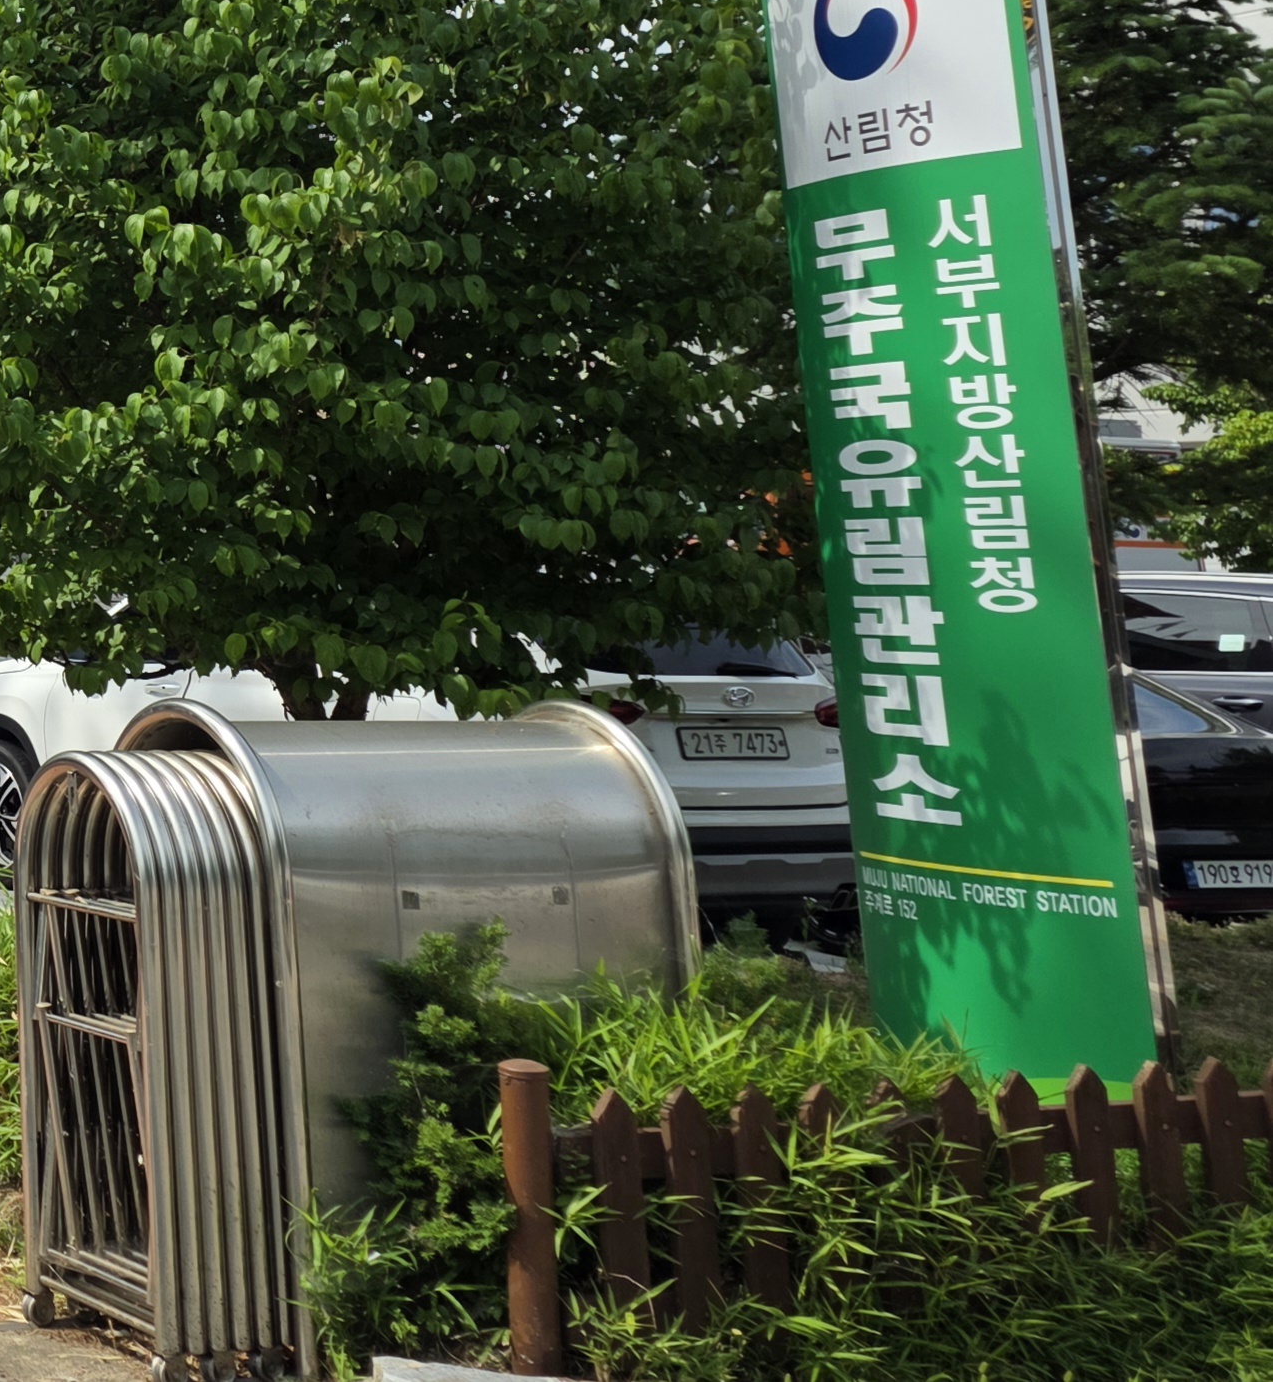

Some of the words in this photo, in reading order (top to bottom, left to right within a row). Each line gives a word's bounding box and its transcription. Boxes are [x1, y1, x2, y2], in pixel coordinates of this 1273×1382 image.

[824, 99, 935, 162] 산림청
[928, 195, 1038, 613] 서부지방산림청
[814, 208, 963, 827] 무주국유림관리소
[691, 733, 727, 754] 21주
[733, 733, 778, 754] 7473
[862, 866, 888, 889] MUJU
[891, 872, 957, 900] NATIONAL
[962, 882, 1027, 909] FOREST
[1036, 890, 1118, 918] STATION
[1198, 864, 1243, 884] 190호
[1244, 864, 1273, 884] 919
[897, 899, 919, 920] 152
